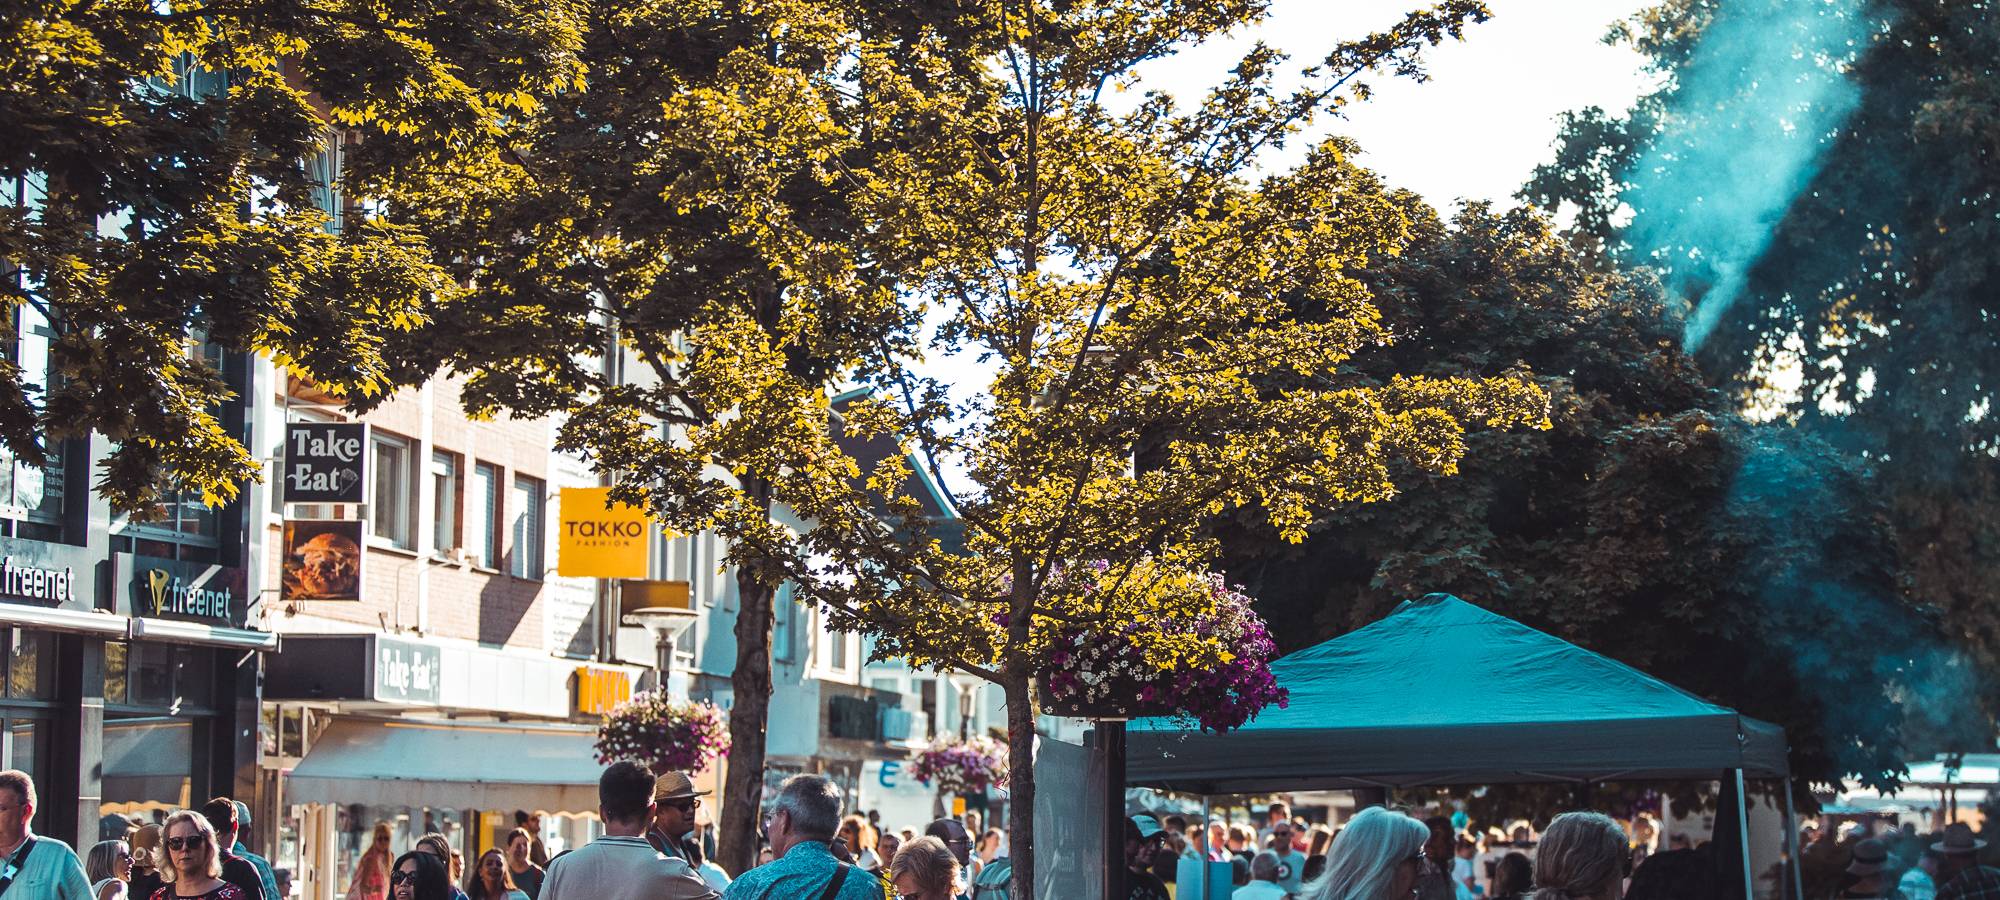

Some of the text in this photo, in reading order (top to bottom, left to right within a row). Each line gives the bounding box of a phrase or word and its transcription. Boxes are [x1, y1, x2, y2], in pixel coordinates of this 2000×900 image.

[292, 429, 360, 462] Take
[287, 464, 340, 491] Eat
[4, 555, 75, 601] freenet
[172, 577, 231, 618] freenet
[382, 648, 430, 696] Take Eat
